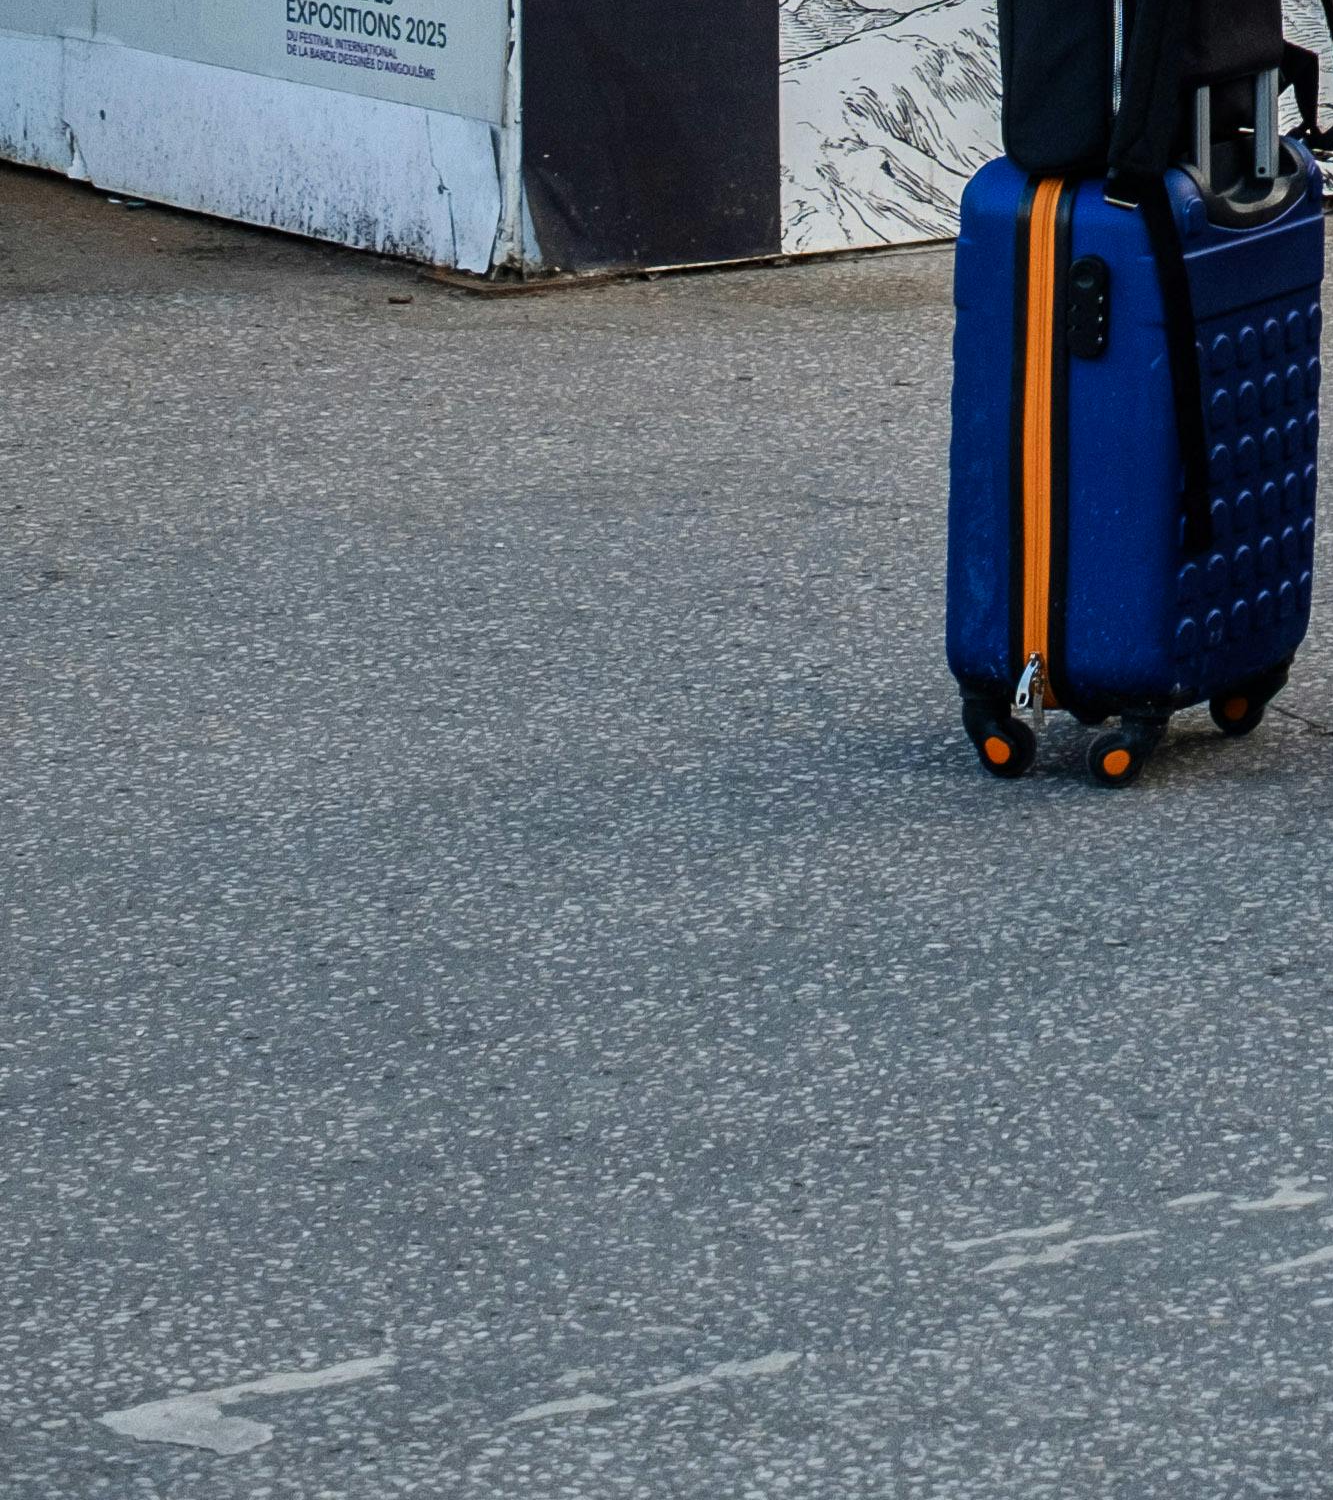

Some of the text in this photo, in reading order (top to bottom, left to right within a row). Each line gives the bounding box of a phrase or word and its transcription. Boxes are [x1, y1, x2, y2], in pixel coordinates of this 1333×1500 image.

[286, 29, 398, 59] DU FESTIVAL INTERNATIONAL
[405, 16, 448, 49] 2025
[286, 43, 299, 56] DE
[299, 45, 309, 57] LA
[309, 47, 337, 63] BANDE
